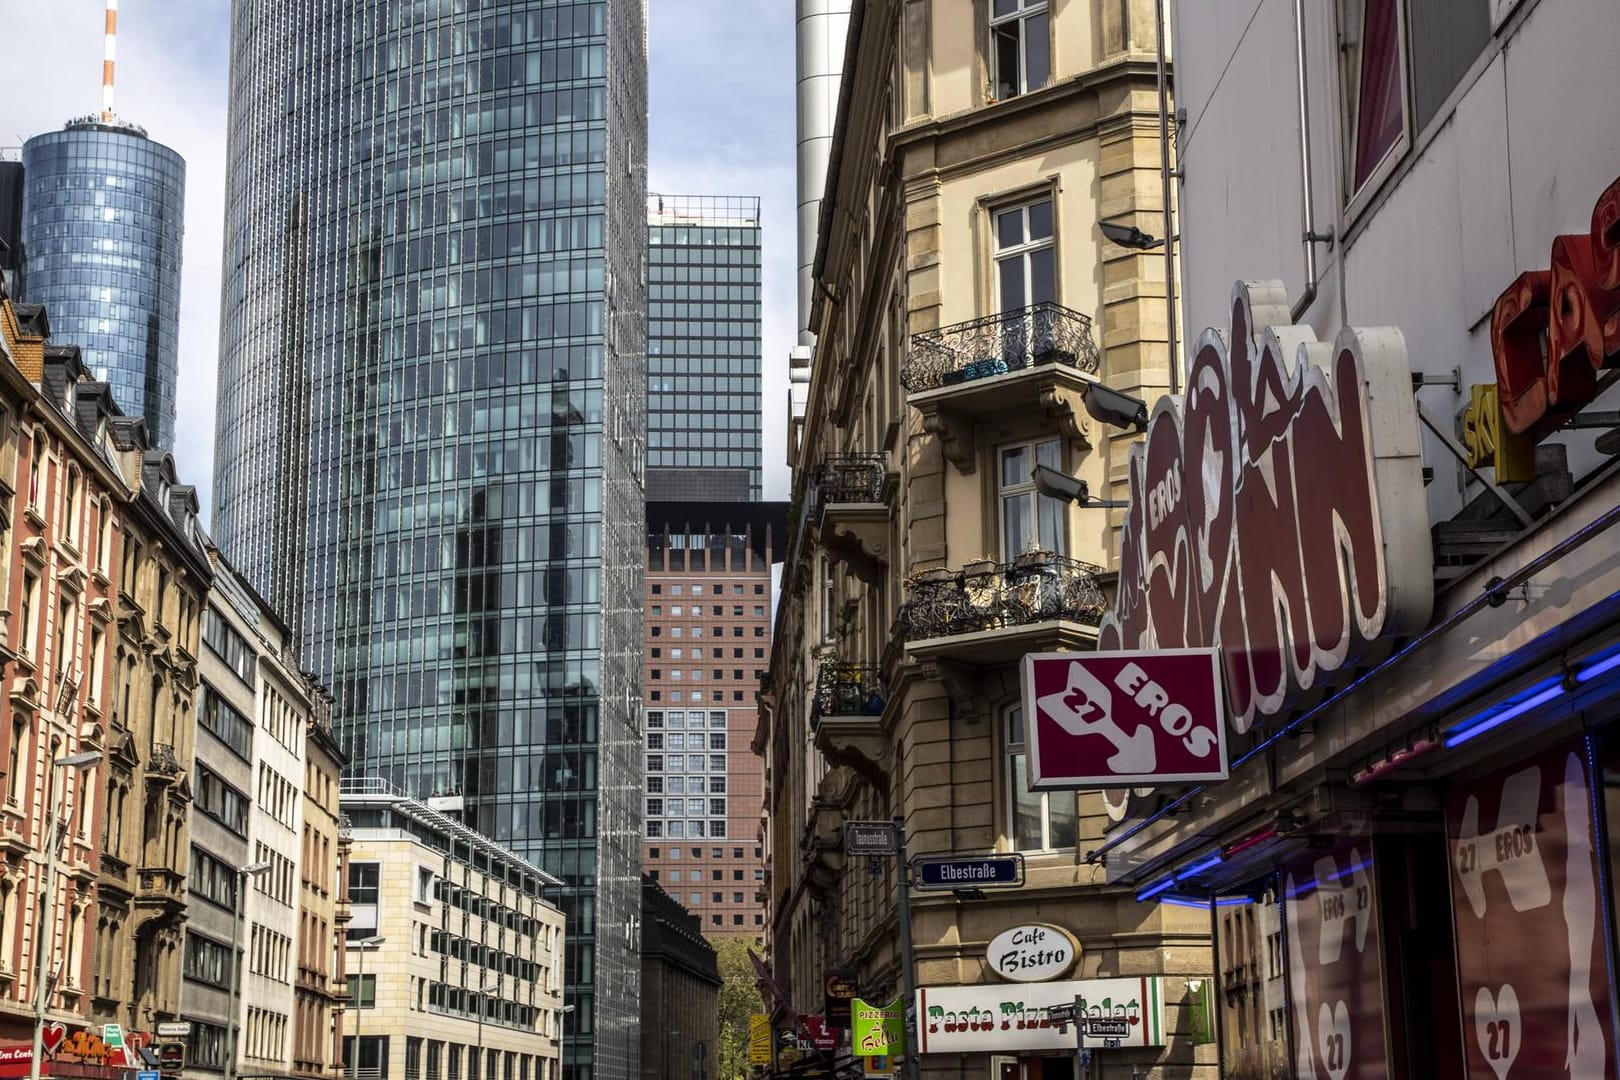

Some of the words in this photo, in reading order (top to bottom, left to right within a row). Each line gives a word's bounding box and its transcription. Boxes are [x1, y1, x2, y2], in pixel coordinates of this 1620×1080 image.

[1149, 457, 1182, 531] EROS
[1062, 686, 1106, 724] 27
[1113, 661, 1218, 758] EROS
[1459, 843, 1476, 874] 27
[1495, 824, 1533, 862] EROS
[940, 863, 997, 881] Elbestraße
[1323, 894, 1345, 922] EROS
[1356, 885, 1368, 911] 27
[1012, 928, 1046, 946] Cafe
[1000, 949, 1066, 973] Bistro
[859, 1011, 900, 1020] PIZZERIA
[928, 1005, 995, 1034] Pasta
[999, 1001, 1062, 1031] Pizz
[1092, 1023, 1125, 1033] Elbestraße
[861, 1030, 899, 1051] Bella
[1326, 1033, 1344, 1071] 27
[1486, 1019, 1510, 1060] 27
